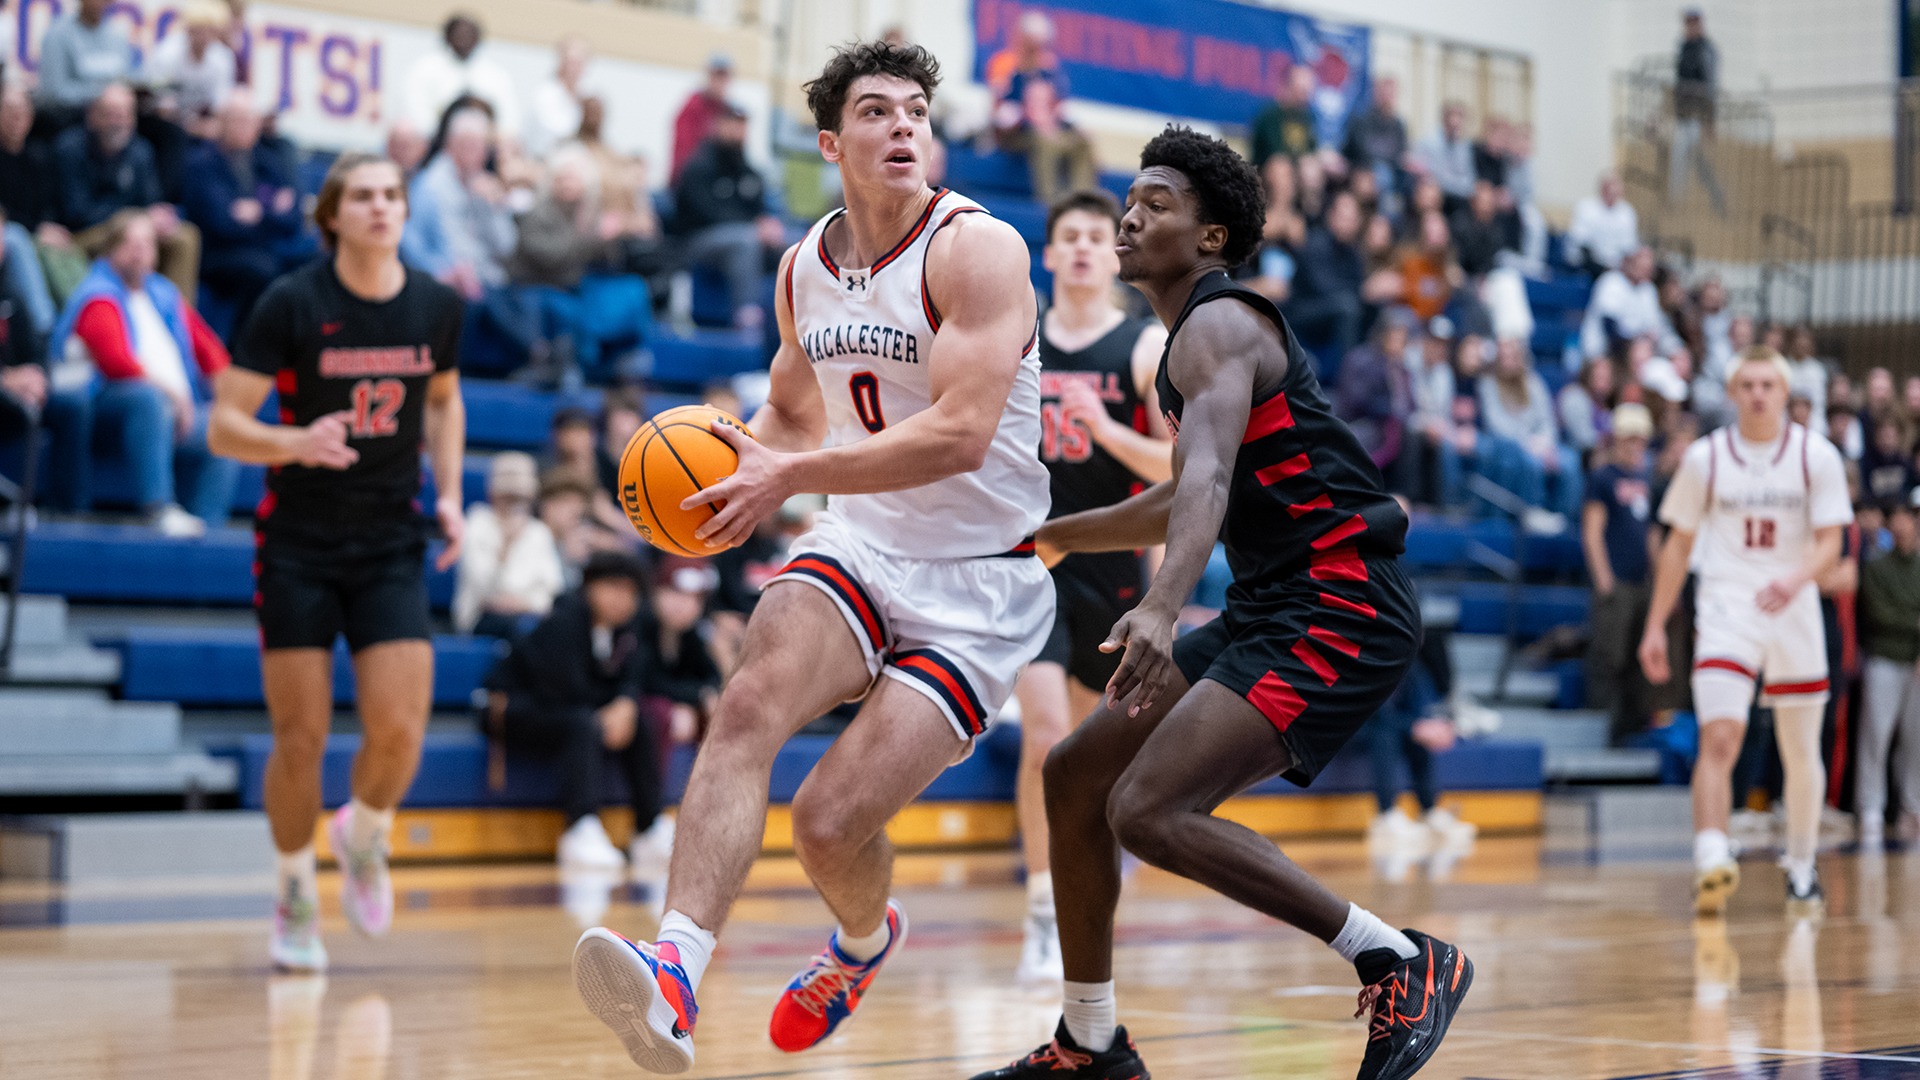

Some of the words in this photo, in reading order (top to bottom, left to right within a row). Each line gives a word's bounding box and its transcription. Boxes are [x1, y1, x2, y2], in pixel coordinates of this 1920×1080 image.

[803, 325, 919, 364] MACALESTER
[351, 380, 406, 437] 12
[849, 371, 886, 434] 0
[1041, 403, 1092, 462] 15
